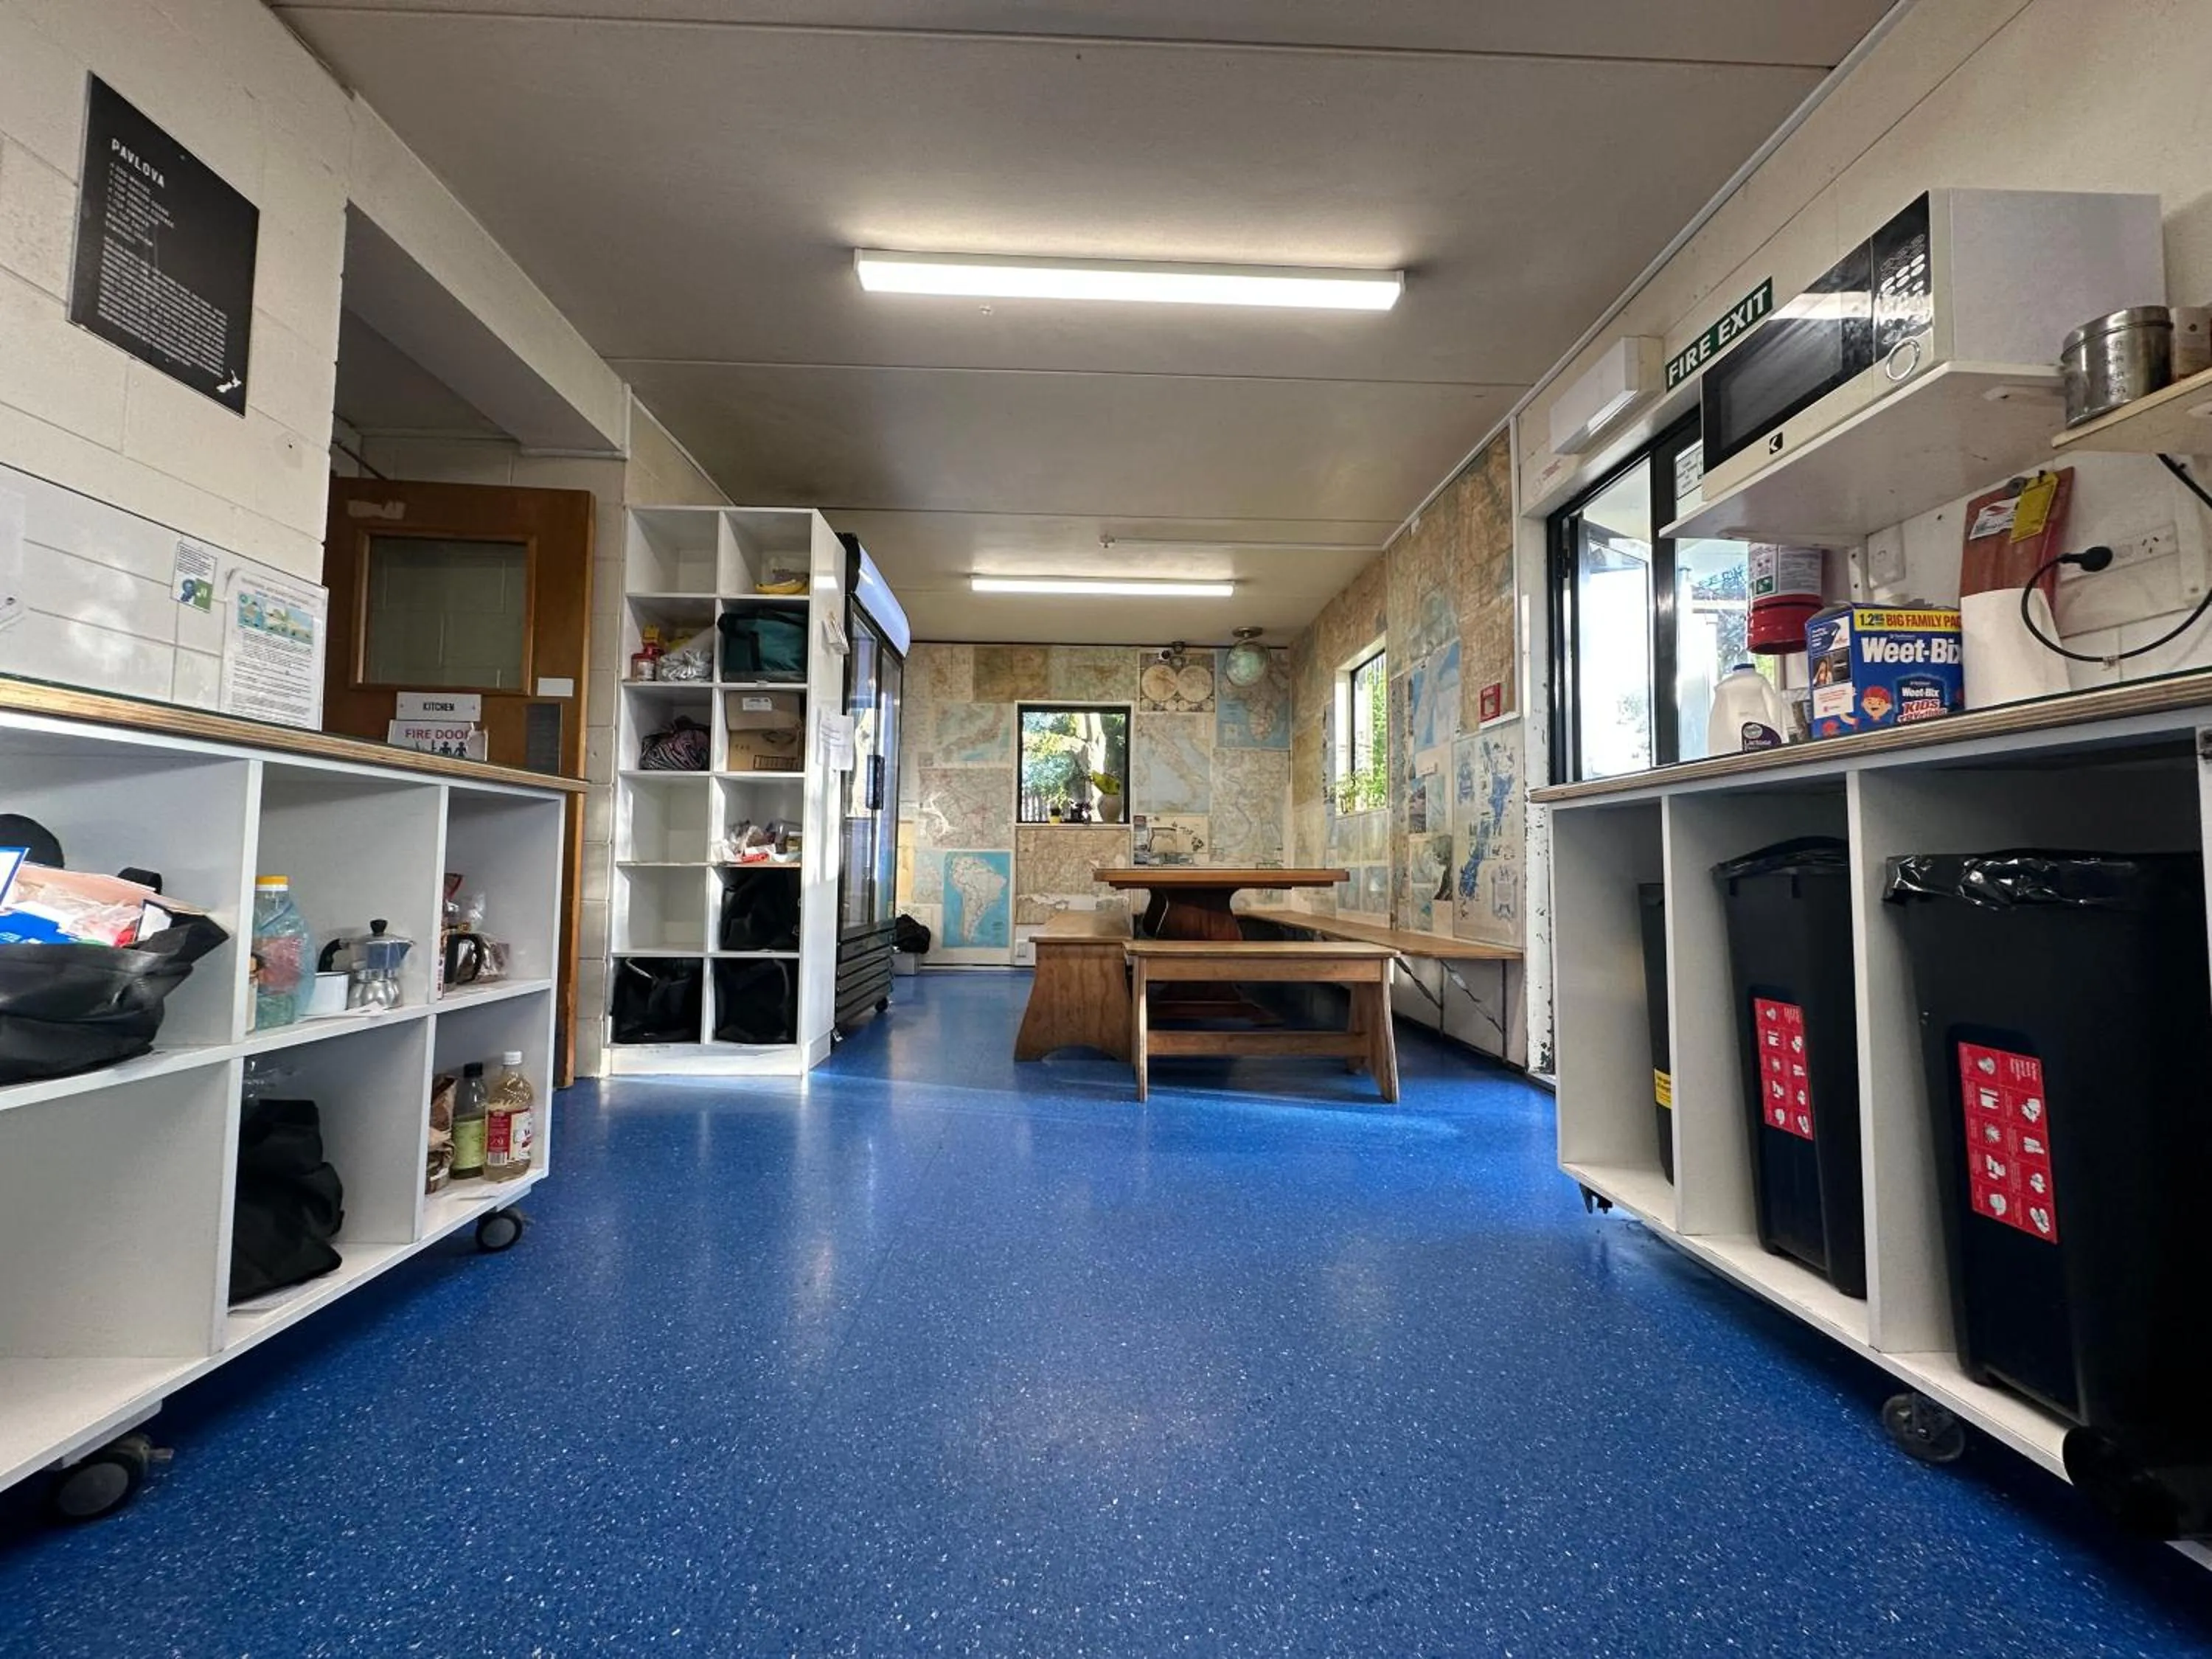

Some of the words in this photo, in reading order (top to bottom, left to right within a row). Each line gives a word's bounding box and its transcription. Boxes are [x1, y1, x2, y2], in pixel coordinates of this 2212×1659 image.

[111, 138, 164, 188] PAVLOVA
[1669, 334, 1711, 387] FIRE
[1717, 286, 1767, 346] EXIT
[1886, 614, 1904, 626] BIG
[1906, 614, 1941, 627] FAMILY
[422, 702, 455, 712] KITCHEN
[405, 728, 431, 740] FIRE
